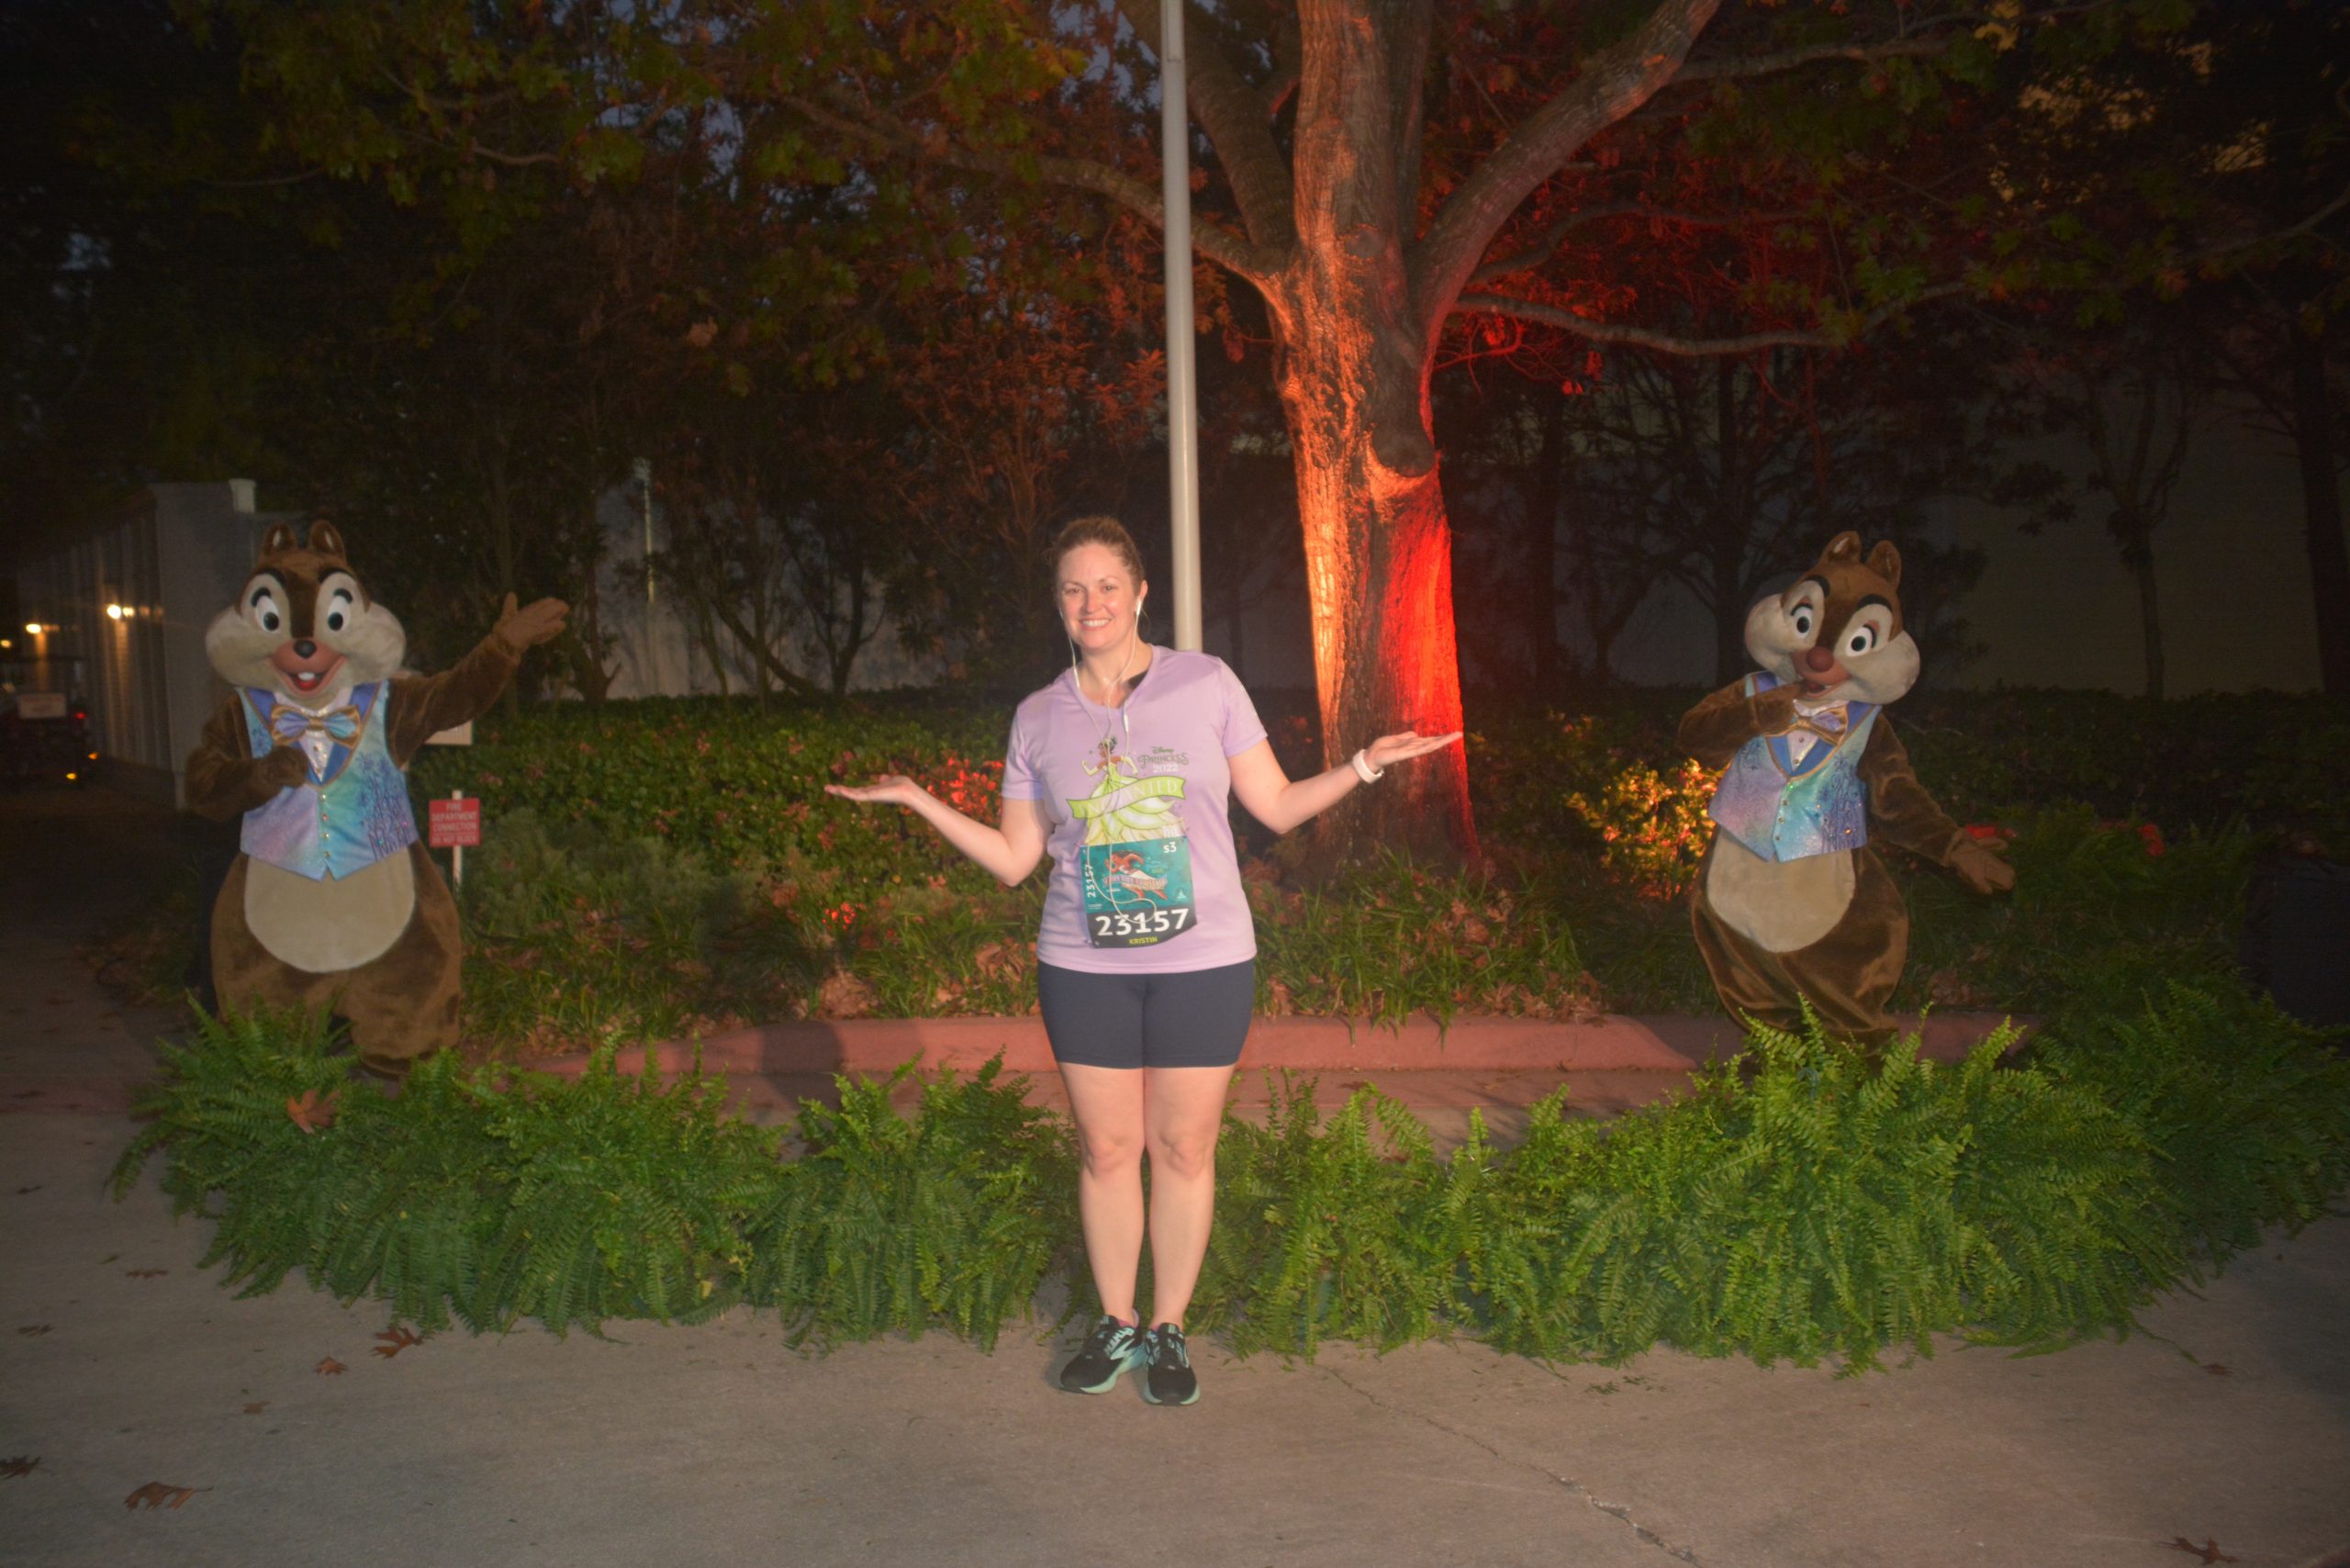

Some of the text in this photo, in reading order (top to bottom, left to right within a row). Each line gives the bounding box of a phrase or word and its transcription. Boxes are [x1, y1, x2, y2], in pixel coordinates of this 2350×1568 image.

[1149, 745, 1175, 755] Disney
[431, 812, 476, 823] DEPARTMENT
[432, 822, 476, 833] CONNECTION
[442, 835, 454, 845] NOT
[1085, 864, 1097, 899] 23157
[1095, 908, 1190, 936] 23157
